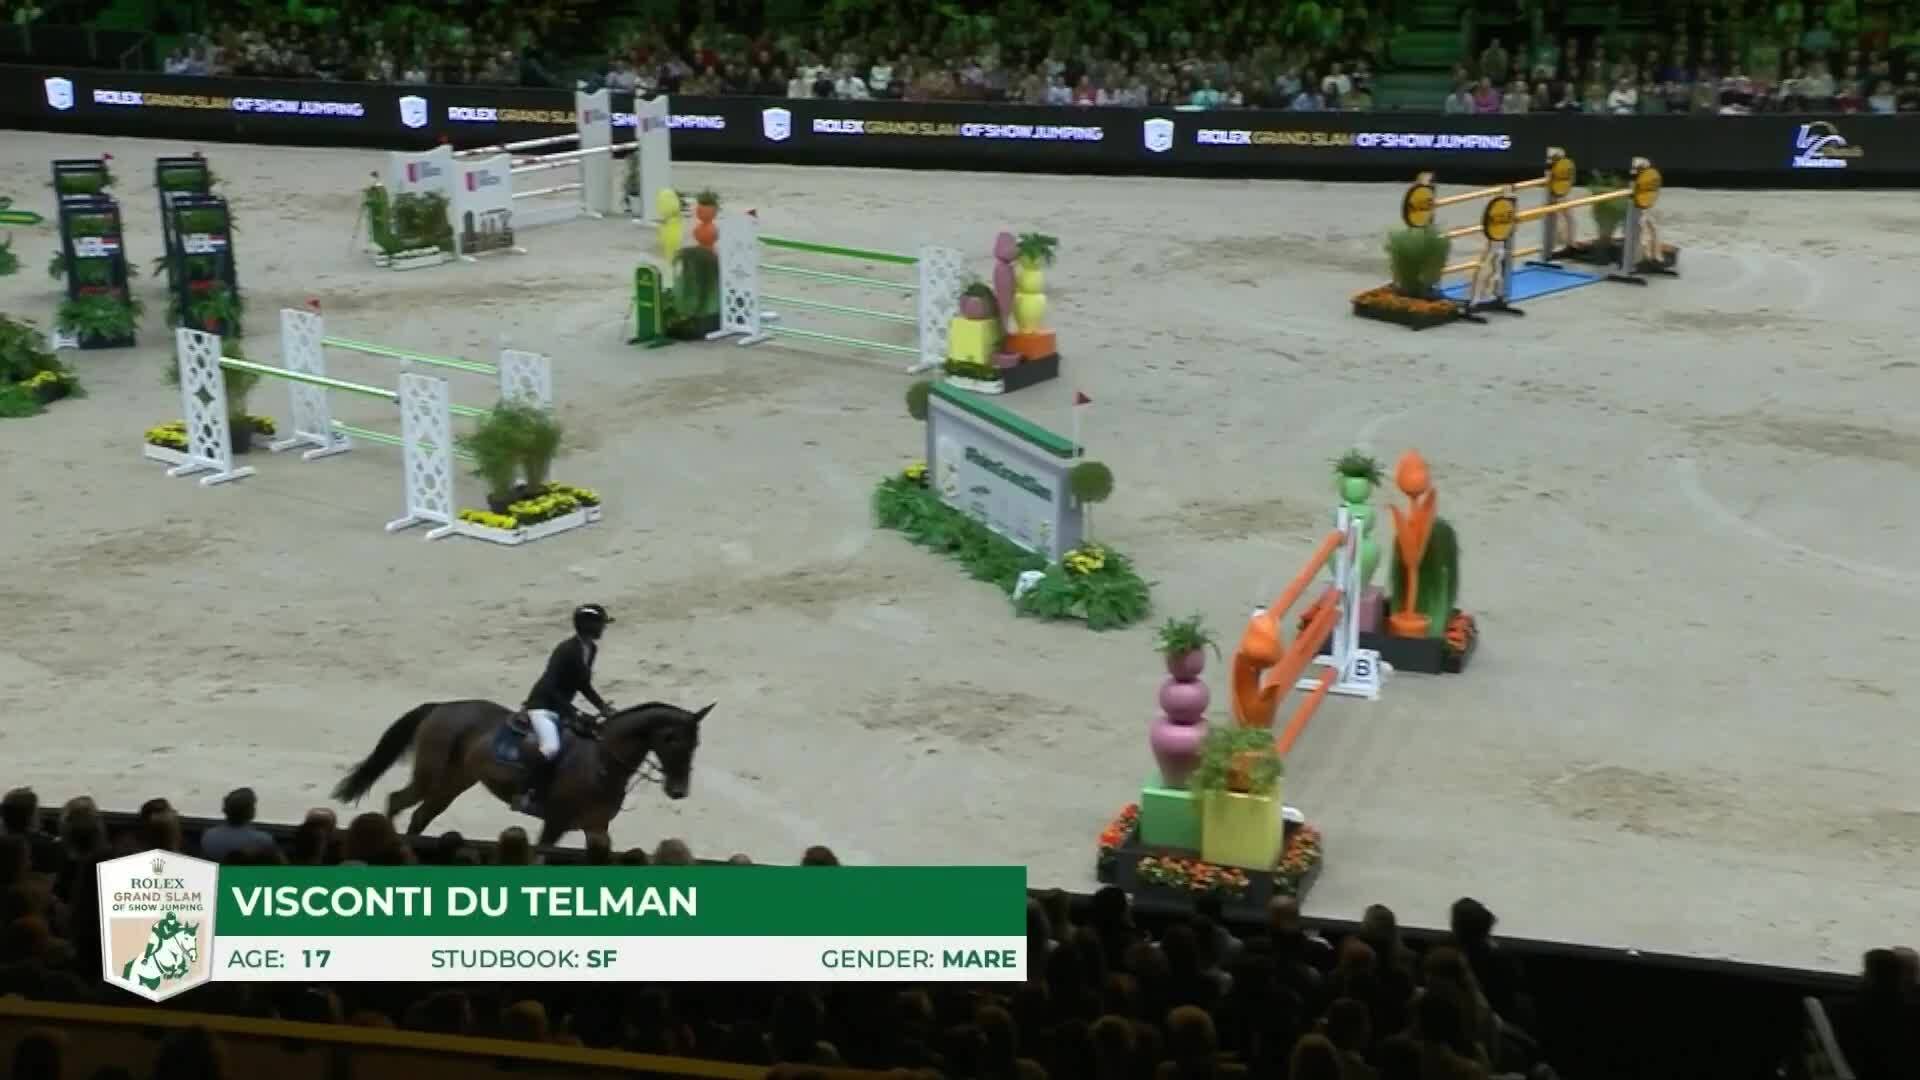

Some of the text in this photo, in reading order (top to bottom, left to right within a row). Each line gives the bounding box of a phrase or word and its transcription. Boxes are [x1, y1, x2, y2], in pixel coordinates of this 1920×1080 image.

[93, 89, 143, 104] ROLEX
[232, 97, 255, 111] OF
[255, 98, 299, 113] SHOW
[300, 101, 365, 116] JUMPING
[448, 106, 497, 120] ROLEX
[498, 108, 550, 122] GRAND
[664, 114, 726, 129] UMPING
[813, 119, 1104, 140] ROLEX GRAND SLAM OF SHOW JUMPING
[1197, 129, 1512, 149] ROLEX GRAND SLAM OF SHOW JUMPING
[1355, 660, 1370, 676] B
